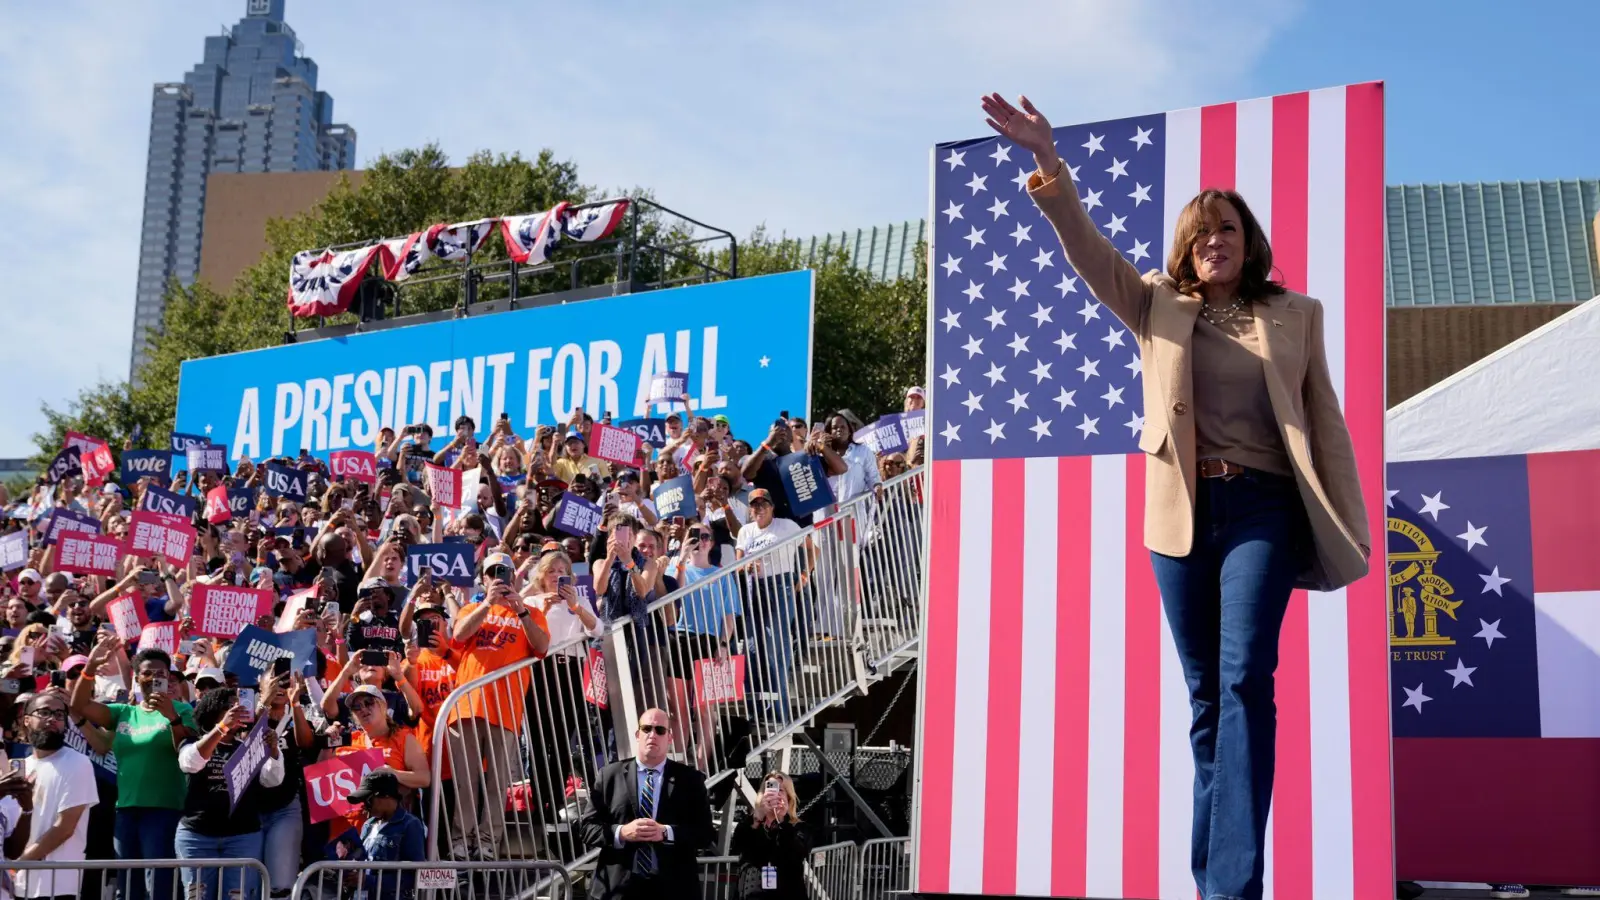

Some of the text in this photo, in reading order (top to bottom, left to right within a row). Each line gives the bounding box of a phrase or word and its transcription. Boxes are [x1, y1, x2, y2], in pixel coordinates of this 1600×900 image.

[231, 326, 727, 460] A PRESIDENT FOR ALL
[601, 427, 636, 445] FREEDOM
[624, 425, 664, 442] SA
[877, 423, 897, 439] VOTE
[600, 436, 636, 454] FREEDOM
[881, 434, 902, 450] WIN
[127, 456, 166, 472] vote
[206, 450, 222, 460] VOTE
[598, 446, 635, 464] FREEDOM
[50, 453, 81, 482] USA
[332, 457, 374, 476] USA
[267, 470, 304, 496] USA
[789, 462, 812, 502] HARRIS
[803, 464, 818, 492] WALZ
[561, 500, 580, 527] WHEN
[578, 505, 593, 519] WE
[574, 516, 591, 533] WE
[132, 522, 152, 549] WHEN
[150, 524, 190, 548] WE VOTE
[60, 538, 77, 566] WHEN
[76, 539, 118, 557] WE VOTE
[148, 537, 187, 562] WE WIN
[74, 553, 117, 571] WE WIN
[410, 553, 471, 577] USA
[1421, 576, 1450, 594] MODER
[206, 589, 258, 608] FREEDOM
[1423, 593, 1450, 610] ATION
[204, 603, 256, 623] FREEDOM
[202, 618, 245, 635] FREEDO
[249, 656, 269, 671] WA
[1390, 651, 1446, 661] E TRUST
[309, 763, 372, 807] USA
[420, 870, 455, 880] NATIONAL
